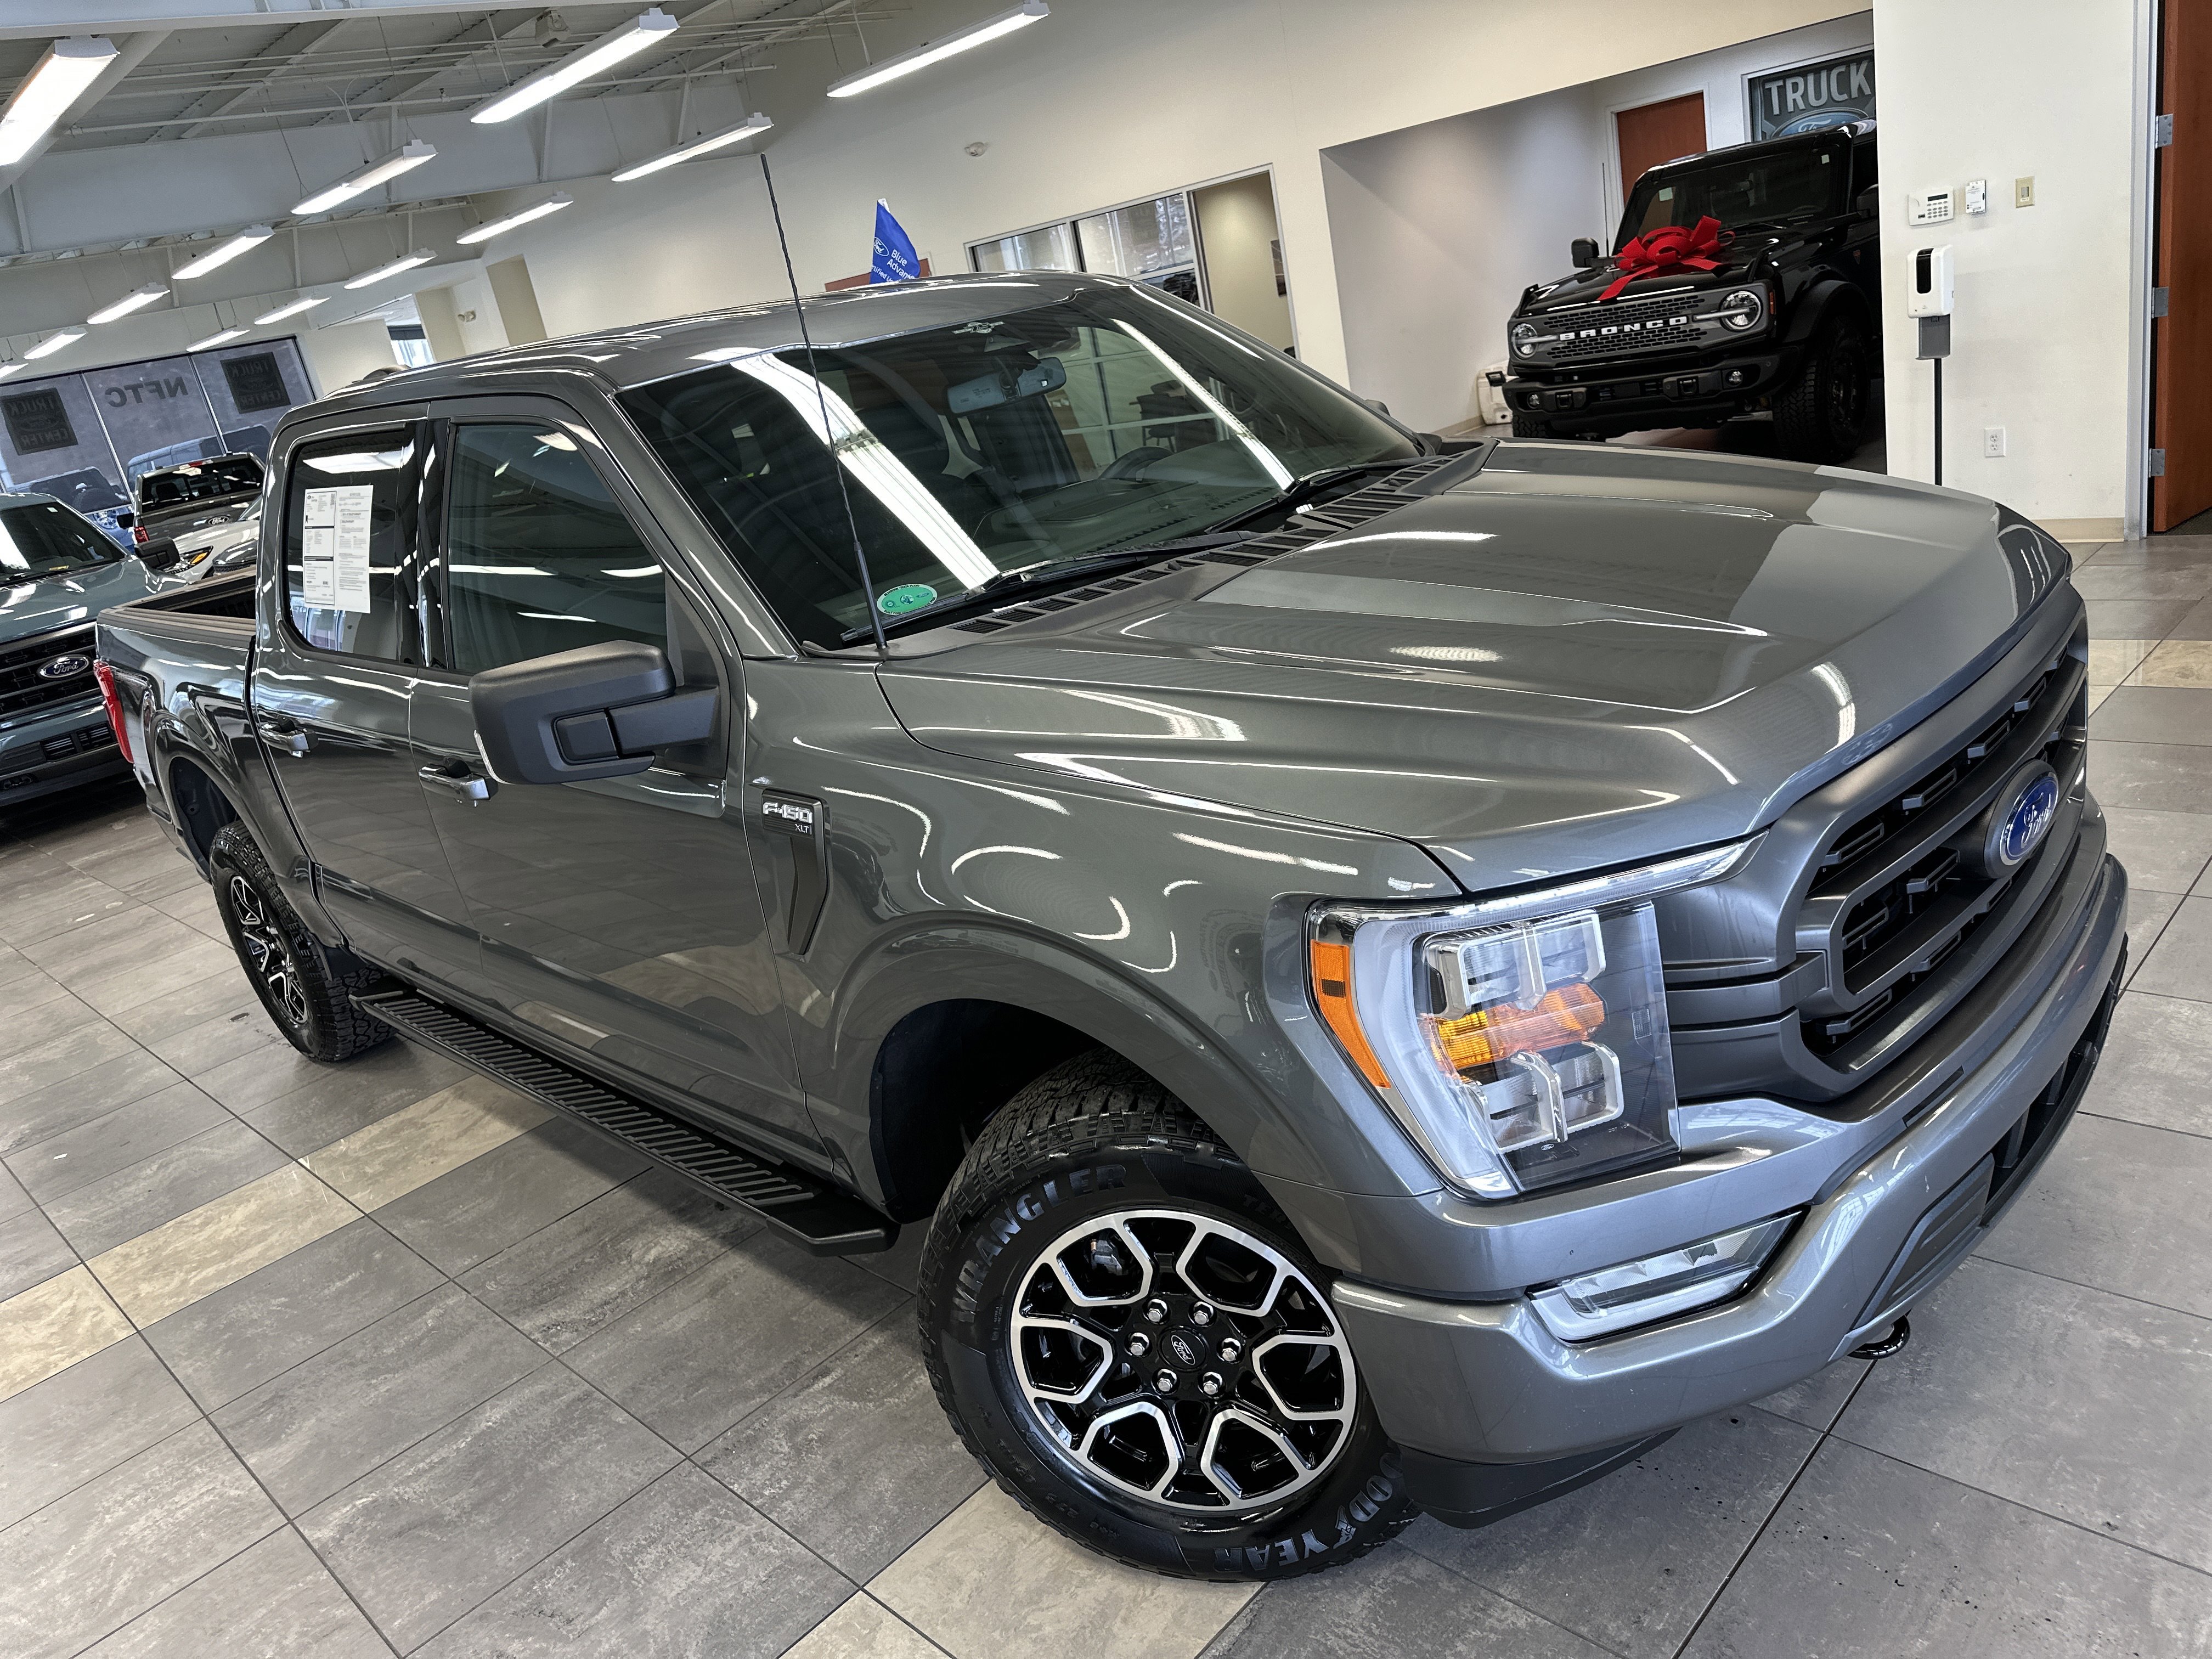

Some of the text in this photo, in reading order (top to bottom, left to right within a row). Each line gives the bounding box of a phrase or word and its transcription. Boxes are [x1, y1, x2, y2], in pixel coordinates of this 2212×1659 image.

[1764, 59, 1871, 115] TRUCK
[891, 249, 907, 267] Blue
[872, 264, 888, 279] rtified
[1559, 315, 1688, 341] BRONCO
[53, 661, 79, 675] Ford
[763, 802, 812, 823] F-150
[2021, 792, 2052, 849] Ford
[794, 823, 809, 833] XLT
[952, 1164, 1128, 1323] WRANGLER
[1173, 1341, 1192, 1361] Ford
[1213, 1452, 1403, 1573] OODYEAR
